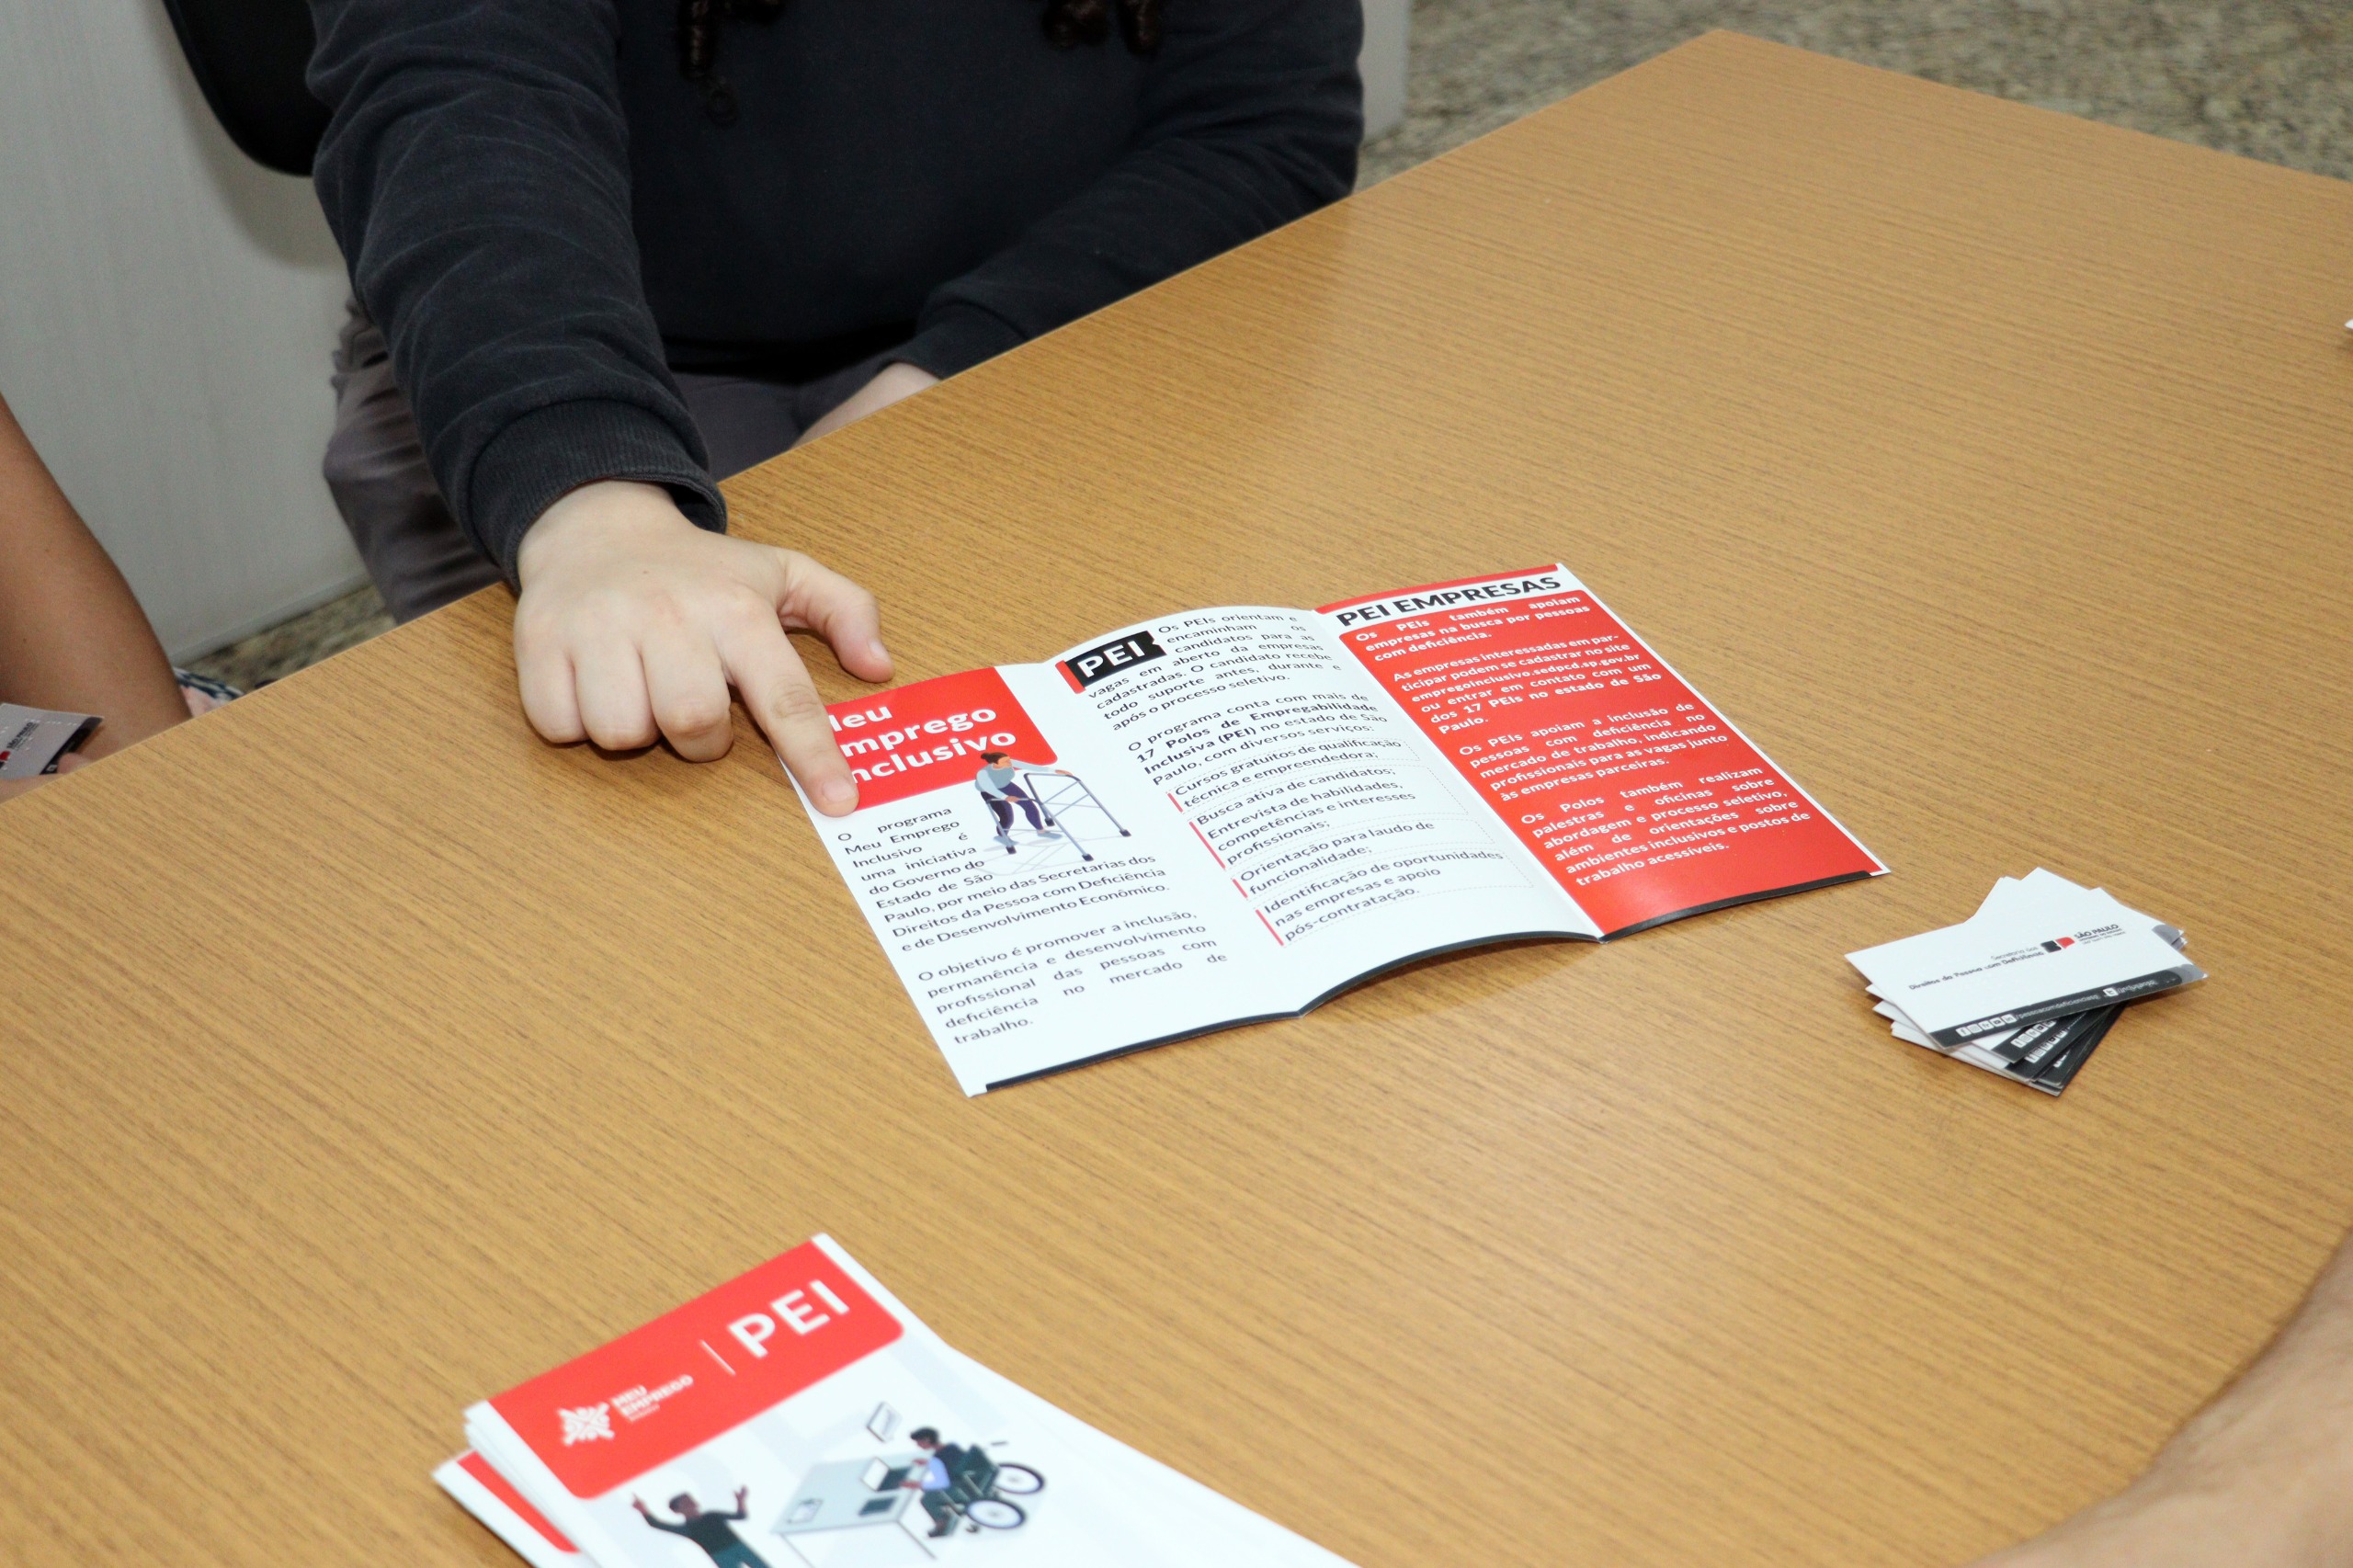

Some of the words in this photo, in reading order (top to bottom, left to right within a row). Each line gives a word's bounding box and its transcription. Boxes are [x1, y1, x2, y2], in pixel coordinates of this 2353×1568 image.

[1336, 604, 1391, 627] PEI
[1392, 576, 1561, 614] EMPRESAS
[1395, 619, 1430, 631] PEIs
[1449, 607, 1509, 621] também
[1528, 597, 1581, 609] apoiam
[1166, 624, 1257, 643] encaminham
[1175, 635, 1254, 653] candidatos
[1365, 631, 1436, 652] empresas
[1459, 619, 1504, 631] busca
[1534, 606, 1591, 620] pessoas
[1374, 648, 1407, 662] com
[1408, 631, 1493, 653] deficiência.
[1077, 641, 1145, 677] PEI
[1088, 677, 1130, 699] vagas
[1172, 651, 1221, 666] aberto
[1097, 672, 1187, 710] cadastradas.
[1210, 653, 1281, 668] candidato
[1285, 653, 1333, 661] recebe
[1401, 675, 1447, 692] ticipar
[1449, 665, 1500, 681] podem
[1518, 651, 1582, 665] cadastrar
[1411, 653, 1640, 702] empregoinclusivo.sedpcd.sp.gov.br
[1413, 656, 1481, 676] empresas
[1479, 642, 1568, 661] interessadas
[1103, 701, 1139, 720] todo
[1148, 678, 1204, 700] suporte
[1215, 667, 1259, 680] antes,
[1267, 662, 1323, 670] durante
[1112, 711, 1147, 731] após
[1160, 685, 1227, 710] processo
[1228, 675, 1290, 688] seletivo.
[1447, 689, 1493, 705] entrar
[1529, 674, 1586, 687] contato
[1462, 702, 1481, 714] 17
[1487, 696, 1524, 708] PEIs
[1554, 682, 1605, 695] estado
[840, 709, 996, 757] mprego
[1136, 748, 1154, 764] 17
[1165, 728, 1211, 749] Polos
[1249, 702, 1379, 722] Empregabilidade
[1143, 741, 1216, 775] Inclusiva
[1218, 726, 1256, 744] (PEI)
[1284, 714, 1336, 726] estado
[1147, 711, 1222, 744] programa
[1226, 700, 1270, 714] conta
[1438, 717, 1489, 735] Paulo.
[1469, 745, 1530, 769] pessoas
[1545, 735, 1578, 747] com
[1592, 720, 1672, 738] deficiência
[1487, 733, 1523, 747] PEIs
[1529, 722, 1586, 737] apoiam
[1606, 708, 1669, 722] inclusão
[851, 733, 1016, 783] nclusivo
[1153, 762, 1202, 786] Paulo,
[1204, 747, 1237, 762] com
[1240, 731, 1305, 750] diversos
[1307, 725, 1375, 735] serviços:
[1175, 770, 1228, 796] Cursos
[1230, 750, 1297, 775] gratuitos
[1318, 739, 1402, 752] qualificação
[1479, 756, 1547, 778] mercado
[1573, 737, 1643, 755] trabalho,
[1643, 724, 1717, 742] indicando
[1489, 759, 1587, 791] profissionais
[1588, 753, 1624, 766] para
[1643, 742, 1688, 755] vagas
[1686, 735, 1728, 749] junto
[1183, 780, 1240, 808] técnica
[1254, 752, 1379, 779] empreendedora;
[1196, 801, 1244, 825] Busca
[1245, 787, 1285, 804] ativa
[1308, 768, 1396, 785] candidatos;
[1520, 772, 1595, 795] empresas
[1595, 758, 1670, 778] parceiras.
[1559, 796, 1605, 813] Polos
[1619, 781, 1684, 799] também
[1698, 767, 1764, 784] realizam
[877, 808, 952, 834] programa
[1207, 803, 1288, 840] Entrevista
[1310, 781, 1404, 801] habilidades,
[1218, 807, 1324, 851] competências
[1338, 793, 1416, 809] interesses
[1531, 811, 1605, 839] palestras
[1654, 790, 1713, 805] oficinas
[1731, 778, 1775, 792] sobre
[1543, 819, 1632, 849] abordagem
[1650, 802, 1719, 822] processo
[1722, 790, 1788, 807] seletivo,
[1554, 844, 1595, 861] além
[1649, 812, 1740, 835] orientações
[1755, 801, 1799, 814] sobre
[844, 841, 882, 855] Meu
[889, 821, 961, 844] Emprego
[852, 846, 923, 869] Inclusivo
[1226, 820, 1330, 866] profissionais;
[1240, 843, 1329, 881] Orientação
[1331, 833, 1368, 847] para
[1368, 824, 1414, 837] laudo
[1565, 844, 1649, 874] ambientes
[1647, 828, 1726, 849] inclusivos
[1738, 816, 1790, 834] postos
[860, 868, 896, 881] uma
[905, 847, 977, 870] iniciativa
[892, 867, 961, 888] Governo
[1249, 847, 1372, 895] funcionalidade;
[1263, 869, 1368, 914] Identificação
[1392, 850, 1504, 868] oportunidades
[1575, 860, 1645, 887] trabalho
[1647, 842, 1730, 865] acessíveis.
[875, 890, 932, 909] Estado
[883, 906, 936, 923] Paulo,
[967, 886, 1007, 902] meio
[1038, 860, 1127, 883] Secretarias
[892, 915, 959, 937] Direitos
[983, 894, 1040, 914] Pessoa
[1042, 885, 1077, 898] com
[1077, 869, 1166, 890] Deficiência
[936, 902, 1078, 943] Desenvolvimento
[1078, 885, 1170, 906] Econômico.
[1275, 910, 1302, 927] nas
[1304, 881, 1381, 912] empresas
[1397, 869, 1441, 882] apoio
[1285, 888, 1420, 942] pós-contratação.
[926, 962, 1039, 999] permanência
[1064, 926, 1207, 960] desenvolvimento
[938, 953, 1007, 976] objetivo
[1025, 927, 1106, 955] promover
[1123, 912, 1197, 928] inclusão,
[936, 978, 1037, 1015] profissional
[1053, 968, 1084, 981] das
[1099, 949, 1165, 971] pessoas
[1181, 940, 1217, 951] com
[945, 997, 1039, 1028] deficiência
[1108, 961, 1184, 984] mercado
[953, 1018, 1033, 1044] trabalho.
[727, 1278, 850, 1358] PEI
